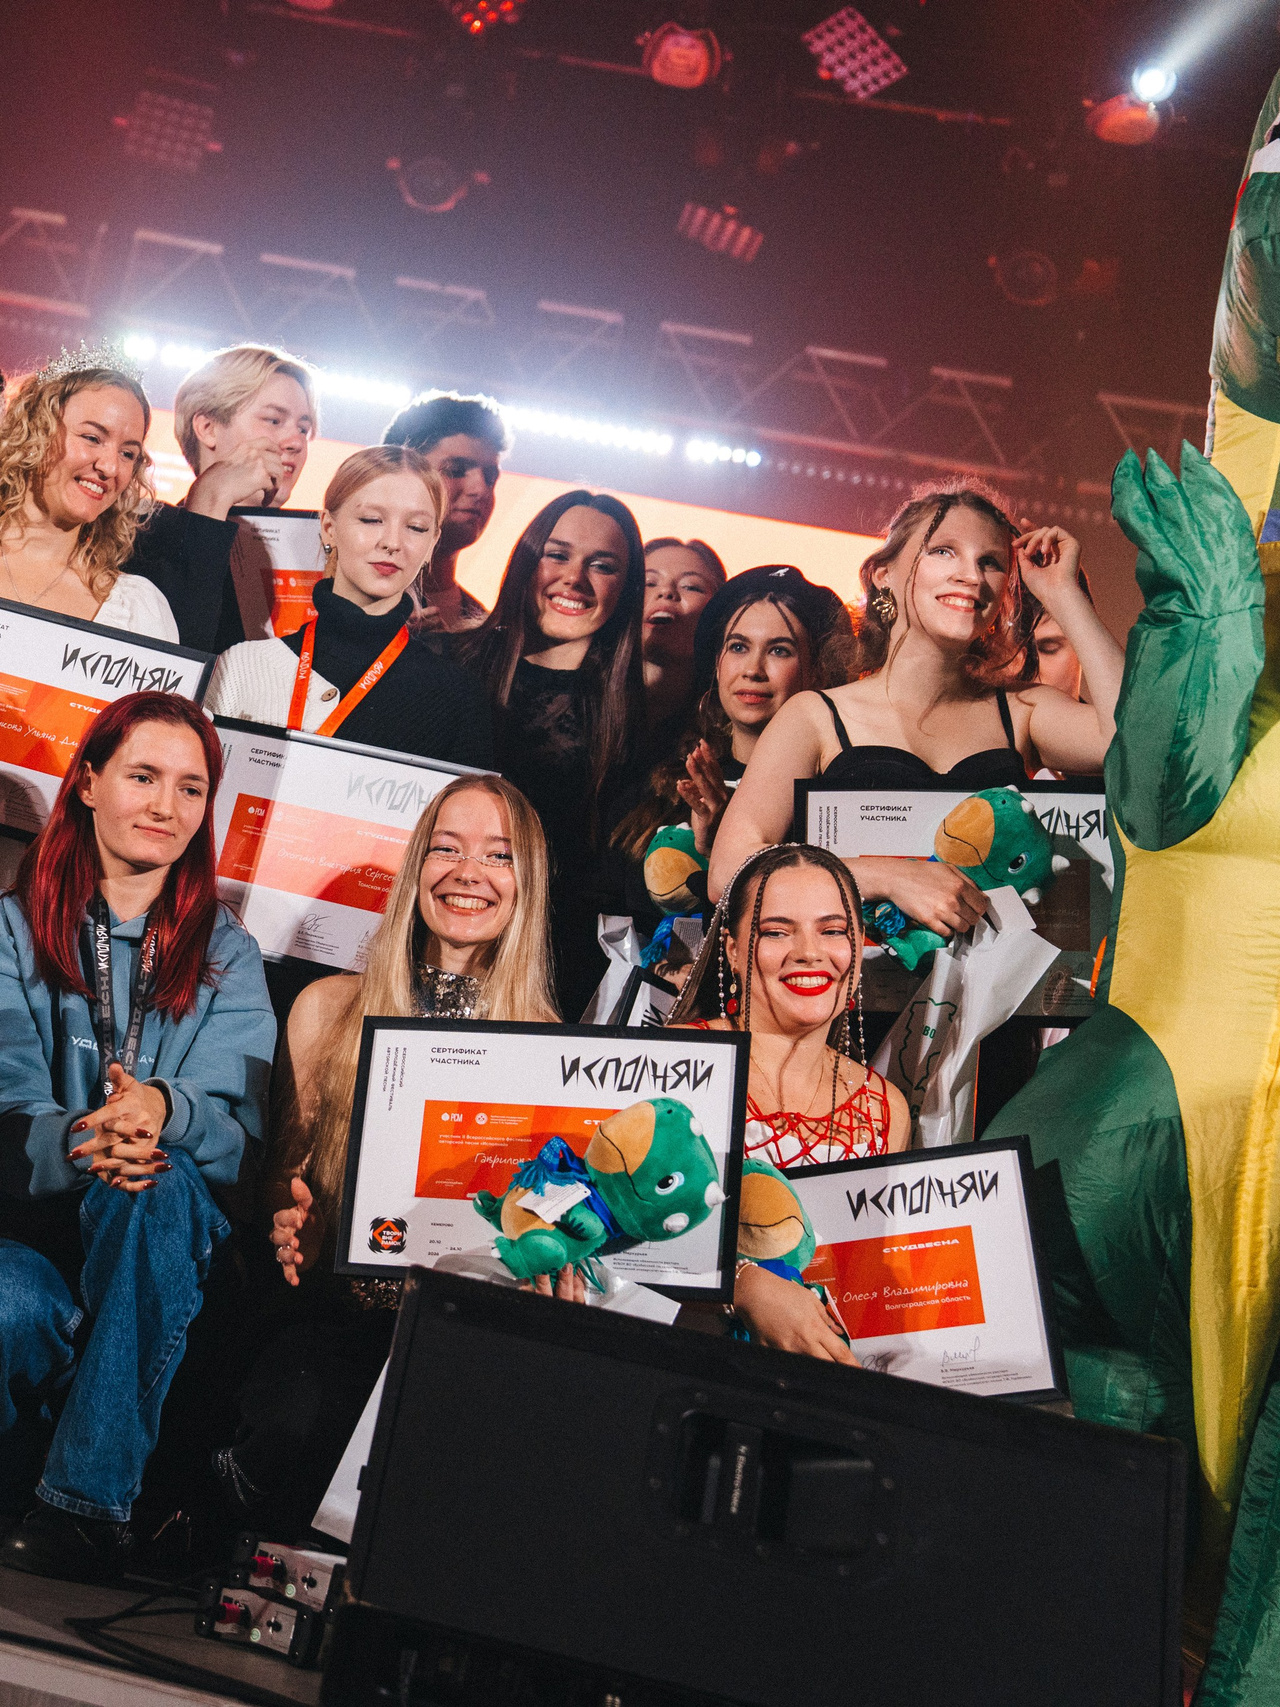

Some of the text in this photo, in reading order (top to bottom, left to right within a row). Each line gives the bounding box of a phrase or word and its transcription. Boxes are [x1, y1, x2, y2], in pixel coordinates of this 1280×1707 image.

[24, 725, 56, 742] Ульяна
[96, 924, 110, 970] ИСПОЛНЯЙ
[431, 1047, 487, 1056] СЕРТИФИКАТ
[430, 1057, 480, 1066] УЧАСТНИКА
[561, 1054, 715, 1094] ИСПОЛНЯЙ
[846, 1169, 999, 1222] ИСПОЛНЯЙ
[882, 1238, 960, 1254] СТУДВЕСНА
[842, 1278, 969, 1304] Олеся Владимировна
[885, 1296, 971, 1311] Волгоградская область
